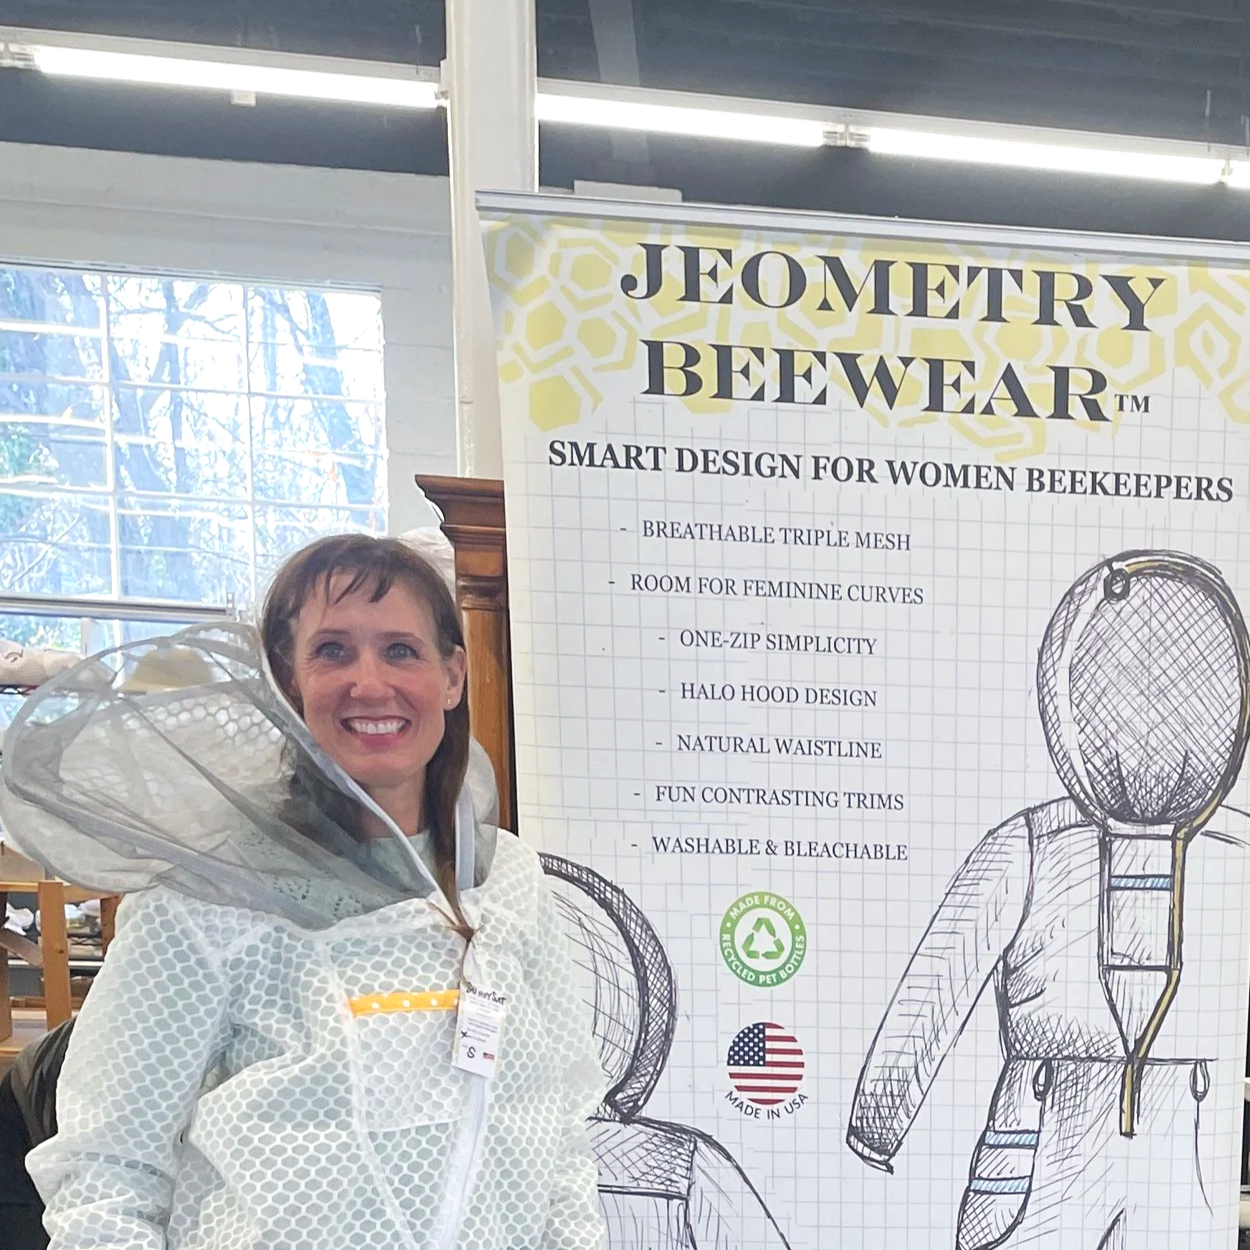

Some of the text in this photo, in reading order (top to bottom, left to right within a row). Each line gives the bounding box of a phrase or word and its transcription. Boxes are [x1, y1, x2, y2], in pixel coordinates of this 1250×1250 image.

[620, 242, 1169, 332] JEOMETRY
[548, 439, 1234, 503] SMART DESIGN FOR WOMEN BEEKEEPERS
[642, 519, 911, 551] BREATHABLE TRIPLE MESH
[631, 573, 925, 606] ROOM FOR FEMININE CURVES
[680, 629, 878, 655] ONE-ZIP SIMPLICITY
[681, 681, 878, 707] HALO HOOD DESIGN
[677, 734, 883, 759] NATURAL WAISTLINE
[656, 785, 905, 811] FUN CONTRASTING TRIMS
[652, 836, 909, 861] WASHABLE & BLEACHABLE
[729, 895, 795, 921] MADE FROM
[722, 933, 805, 985] RECYCLED PET BOTTLES
[724, 1090, 809, 1120] MADE IN USA
